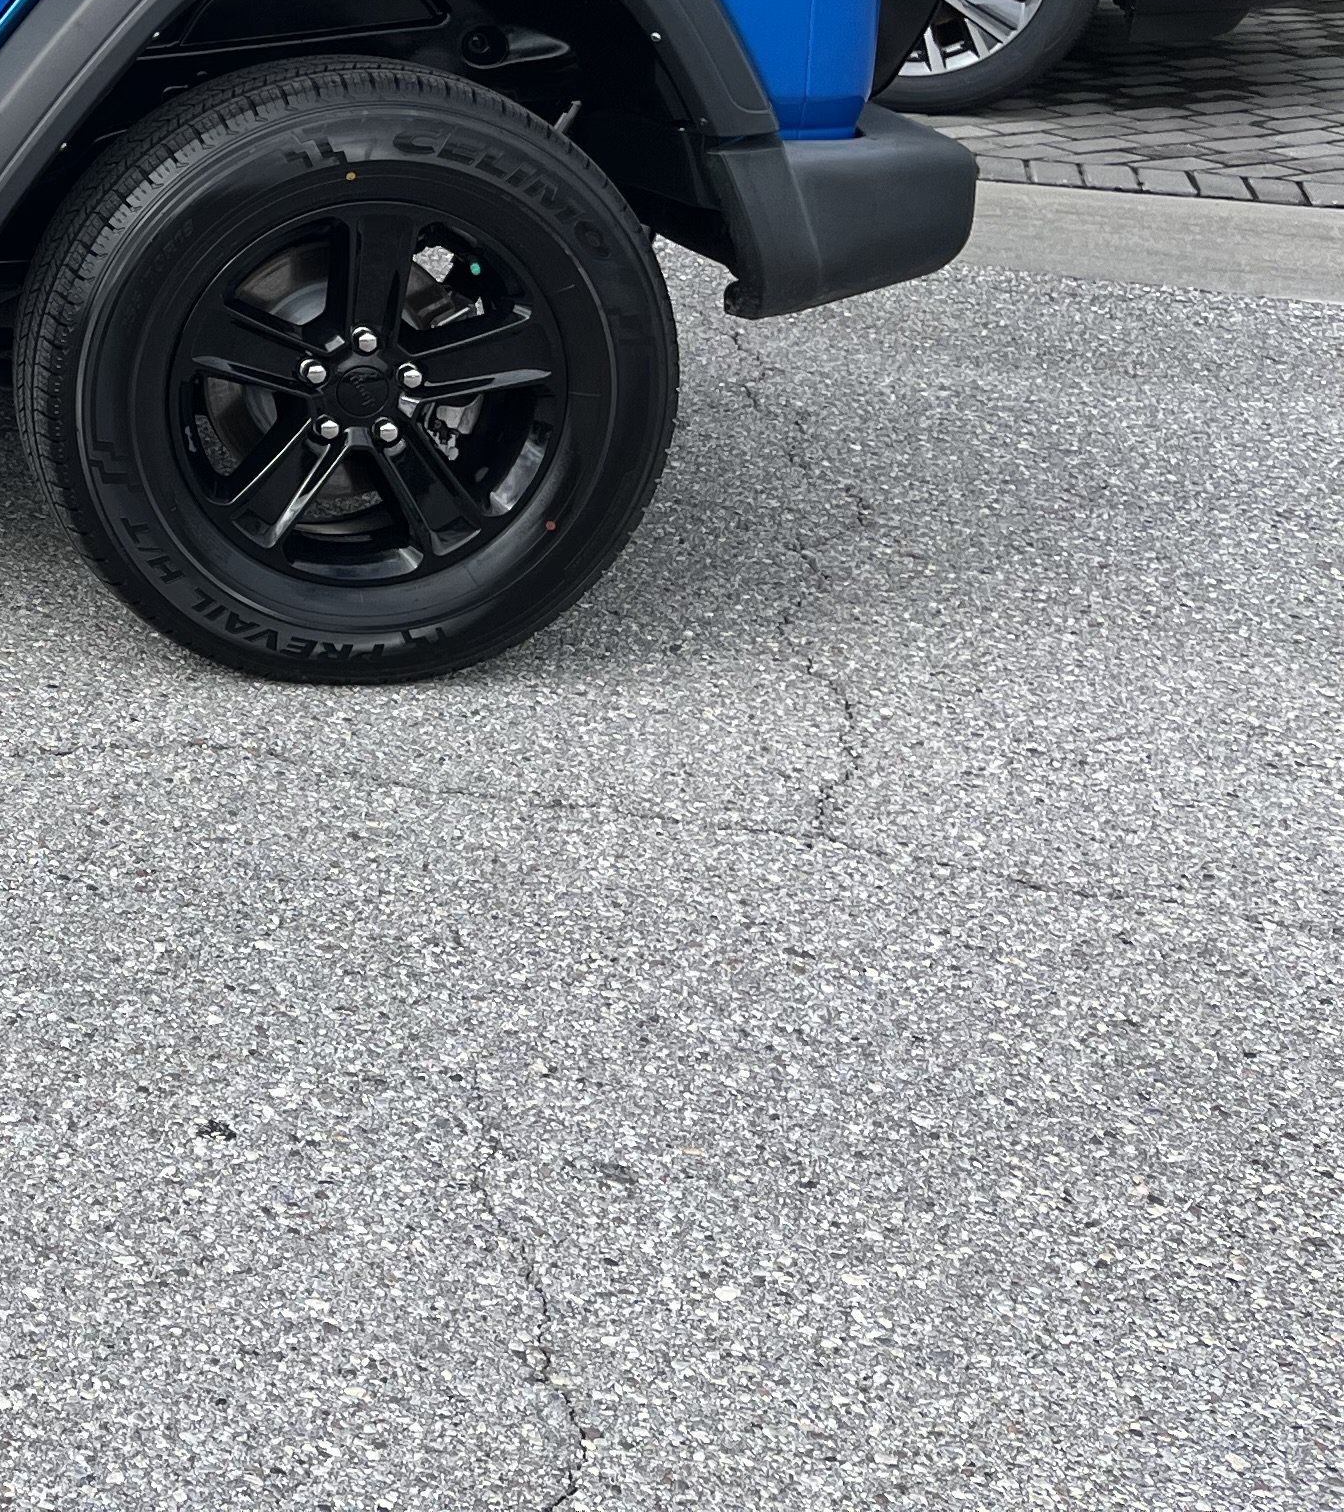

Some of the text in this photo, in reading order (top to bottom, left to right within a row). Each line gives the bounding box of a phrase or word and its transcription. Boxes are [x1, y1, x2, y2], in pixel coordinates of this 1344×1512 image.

[393, 127, 611, 259] CELIMO
[119, 516, 386, 660] PREVAIL H/T
